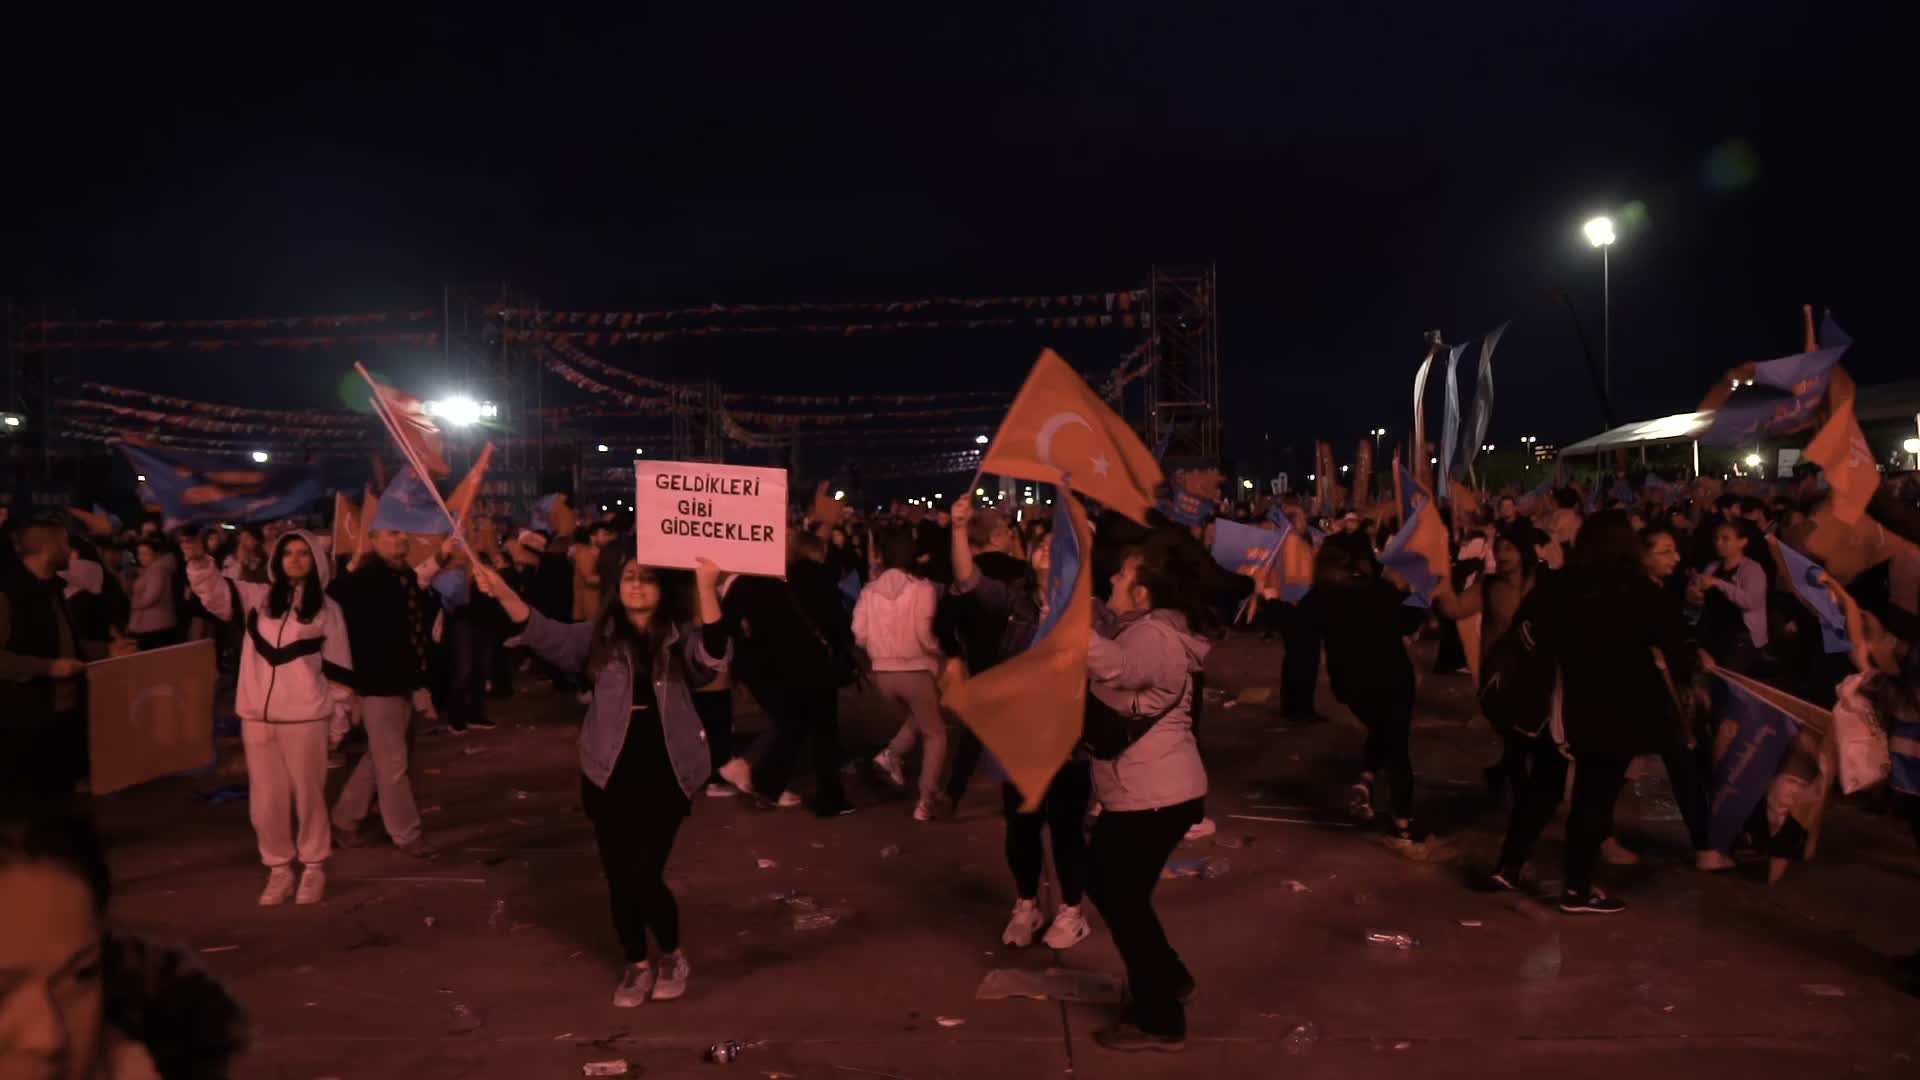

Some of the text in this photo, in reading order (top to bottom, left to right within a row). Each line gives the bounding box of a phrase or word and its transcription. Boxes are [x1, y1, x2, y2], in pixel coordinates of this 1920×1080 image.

[655, 473, 760, 496] GELDİKLERİ
[678, 497, 713, 518] GİBİ
[661, 516, 775, 542] GİDECEKLER
